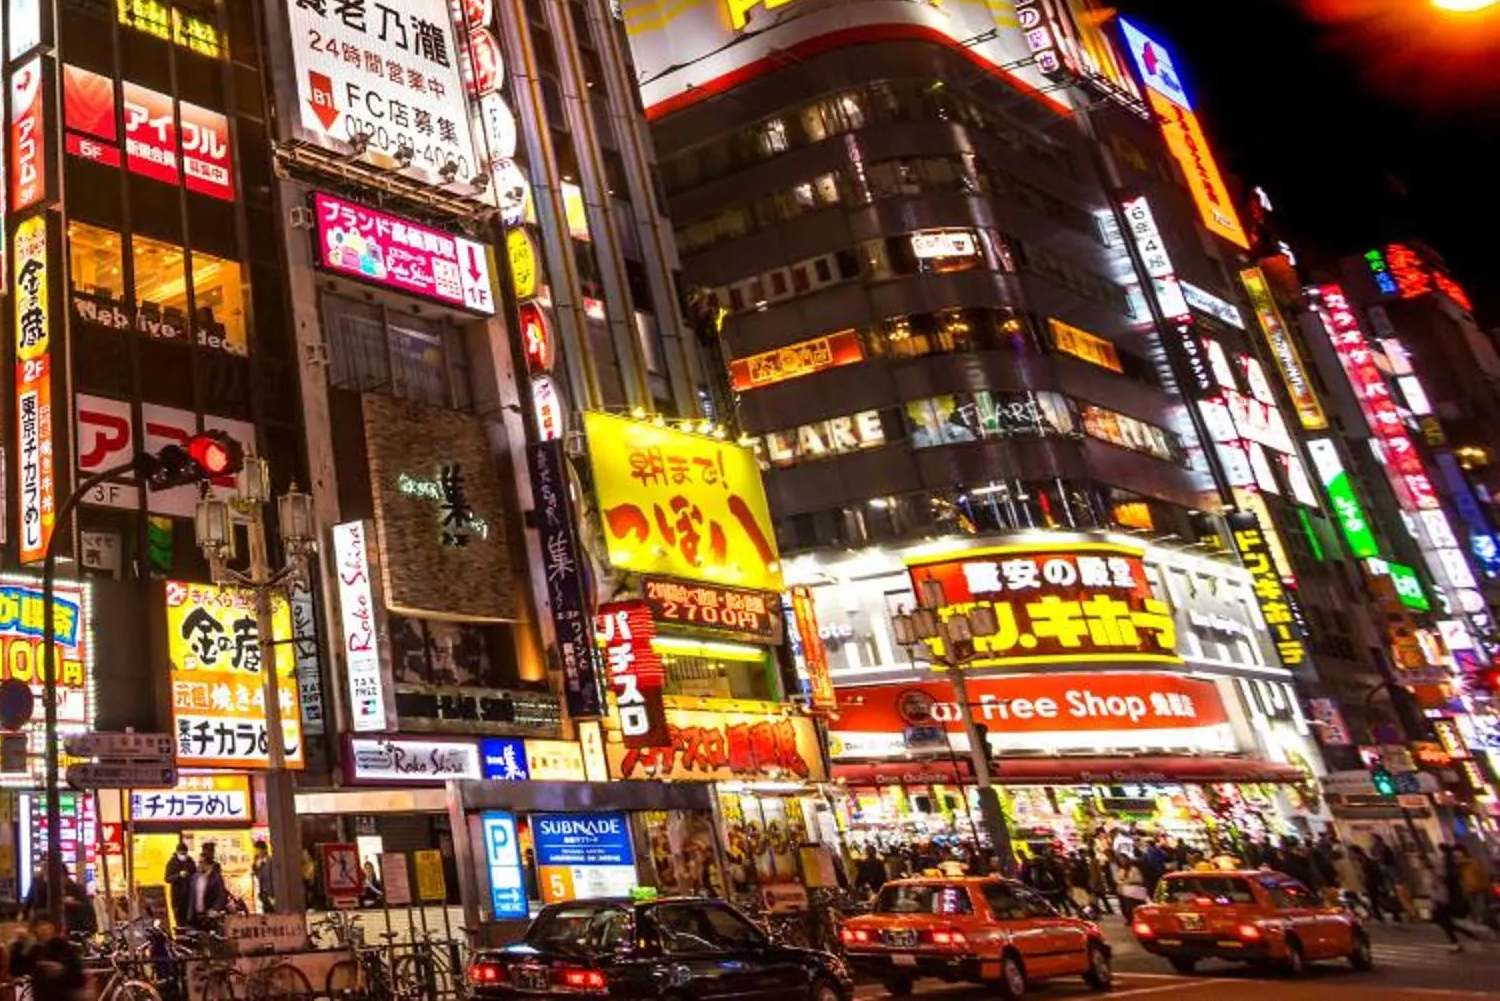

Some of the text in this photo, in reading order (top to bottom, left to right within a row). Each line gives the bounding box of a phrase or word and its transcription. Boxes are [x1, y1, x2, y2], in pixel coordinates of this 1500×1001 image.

[308, 29, 446, 97] 24時間営業中
[311, 88, 333, 109] B1
[123, 102, 229, 159] アイフル
[18, 117, 37, 185] アコム
[23, 359, 45, 383] 2F
[93, 485, 121, 503] 3F
[662, 601, 760, 630] 2700円
[181, 606, 261, 673] 金の蔵
[602, 612, 651, 738] パチスロ
[979, 693, 1059, 721] Free
[1065, 689, 1148, 722] Shop
[144, 794, 242, 817] チカラめし
[489, 824, 509, 861] P
[540, 819, 621, 836] SUBNADE
[549, 874, 566, 898] 5
